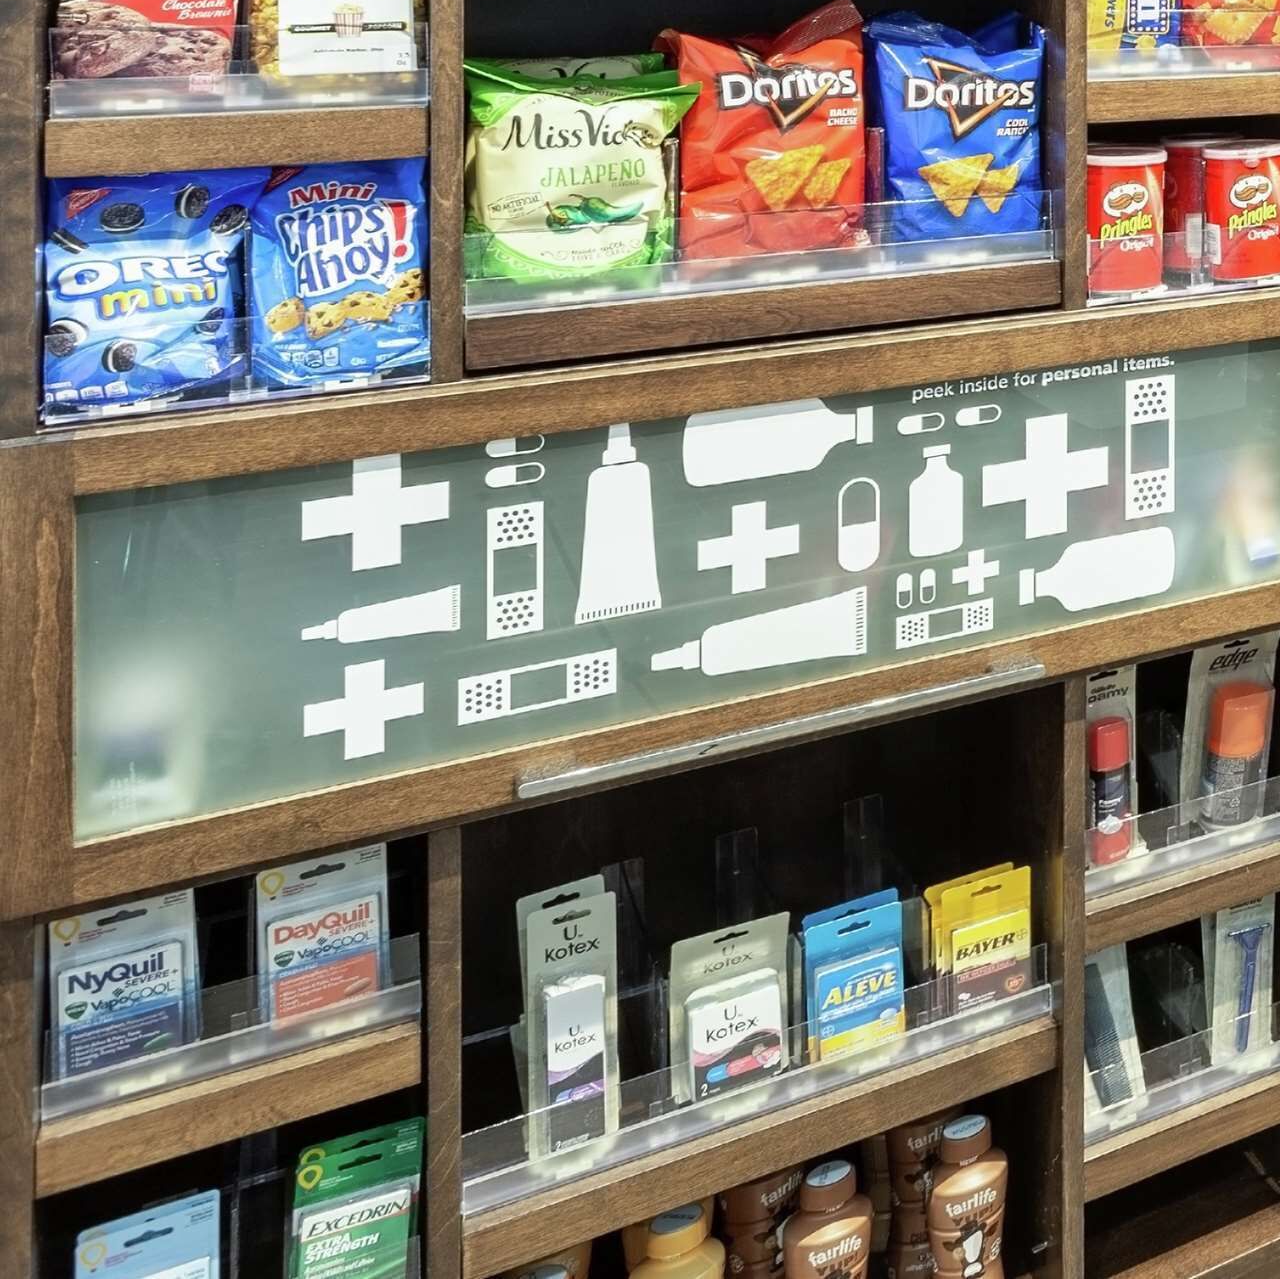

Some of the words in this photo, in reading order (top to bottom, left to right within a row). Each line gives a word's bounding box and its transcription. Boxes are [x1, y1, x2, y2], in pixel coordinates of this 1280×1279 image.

[719, 67, 857, 111] Doritos
[906, 77, 1036, 111] Doritos
[827, 116, 859, 128] CHEESE
[829, 107, 859, 119] NACHO
[502, 113, 585, 151] Miss
[541, 158, 646, 189] JALAPEÑO
[289, 182, 378, 209] Mini
[278, 204, 385, 261] Chips
[1099, 210, 1153, 250] Pringles
[1229, 200, 1278, 240] Pringles
[298, 203, 412, 293] Ahoy!
[102, 279, 217, 319] mini
[912, 382, 954, 404] peek
[959, 375, 1009, 395] inside
[1013, 371, 1037, 388] for
[1041, 359, 1118, 387] personal
[1123, 354, 1176, 372] items.
[1210, 648, 1259, 672] edge
[274, 901, 371, 946] DayQuil
[297, 930, 372, 960] VapoCOOL
[956, 931, 1017, 962] BAYER
[68, 951, 165, 995] NyQuil
[125, 969, 170, 989] SEVERE
[821, 969, 897, 1011] ALEVE
[91, 981, 176, 1012] VapoCOOL
[307, 1198, 408, 1238] EXCEDRIN
[945, 1186, 998, 1219] fairlife
[303, 1232, 381, 1265] STRENGTH
[305, 1232, 353, 1256] EXTRA
[808, 1234, 863, 1268] fairlife
